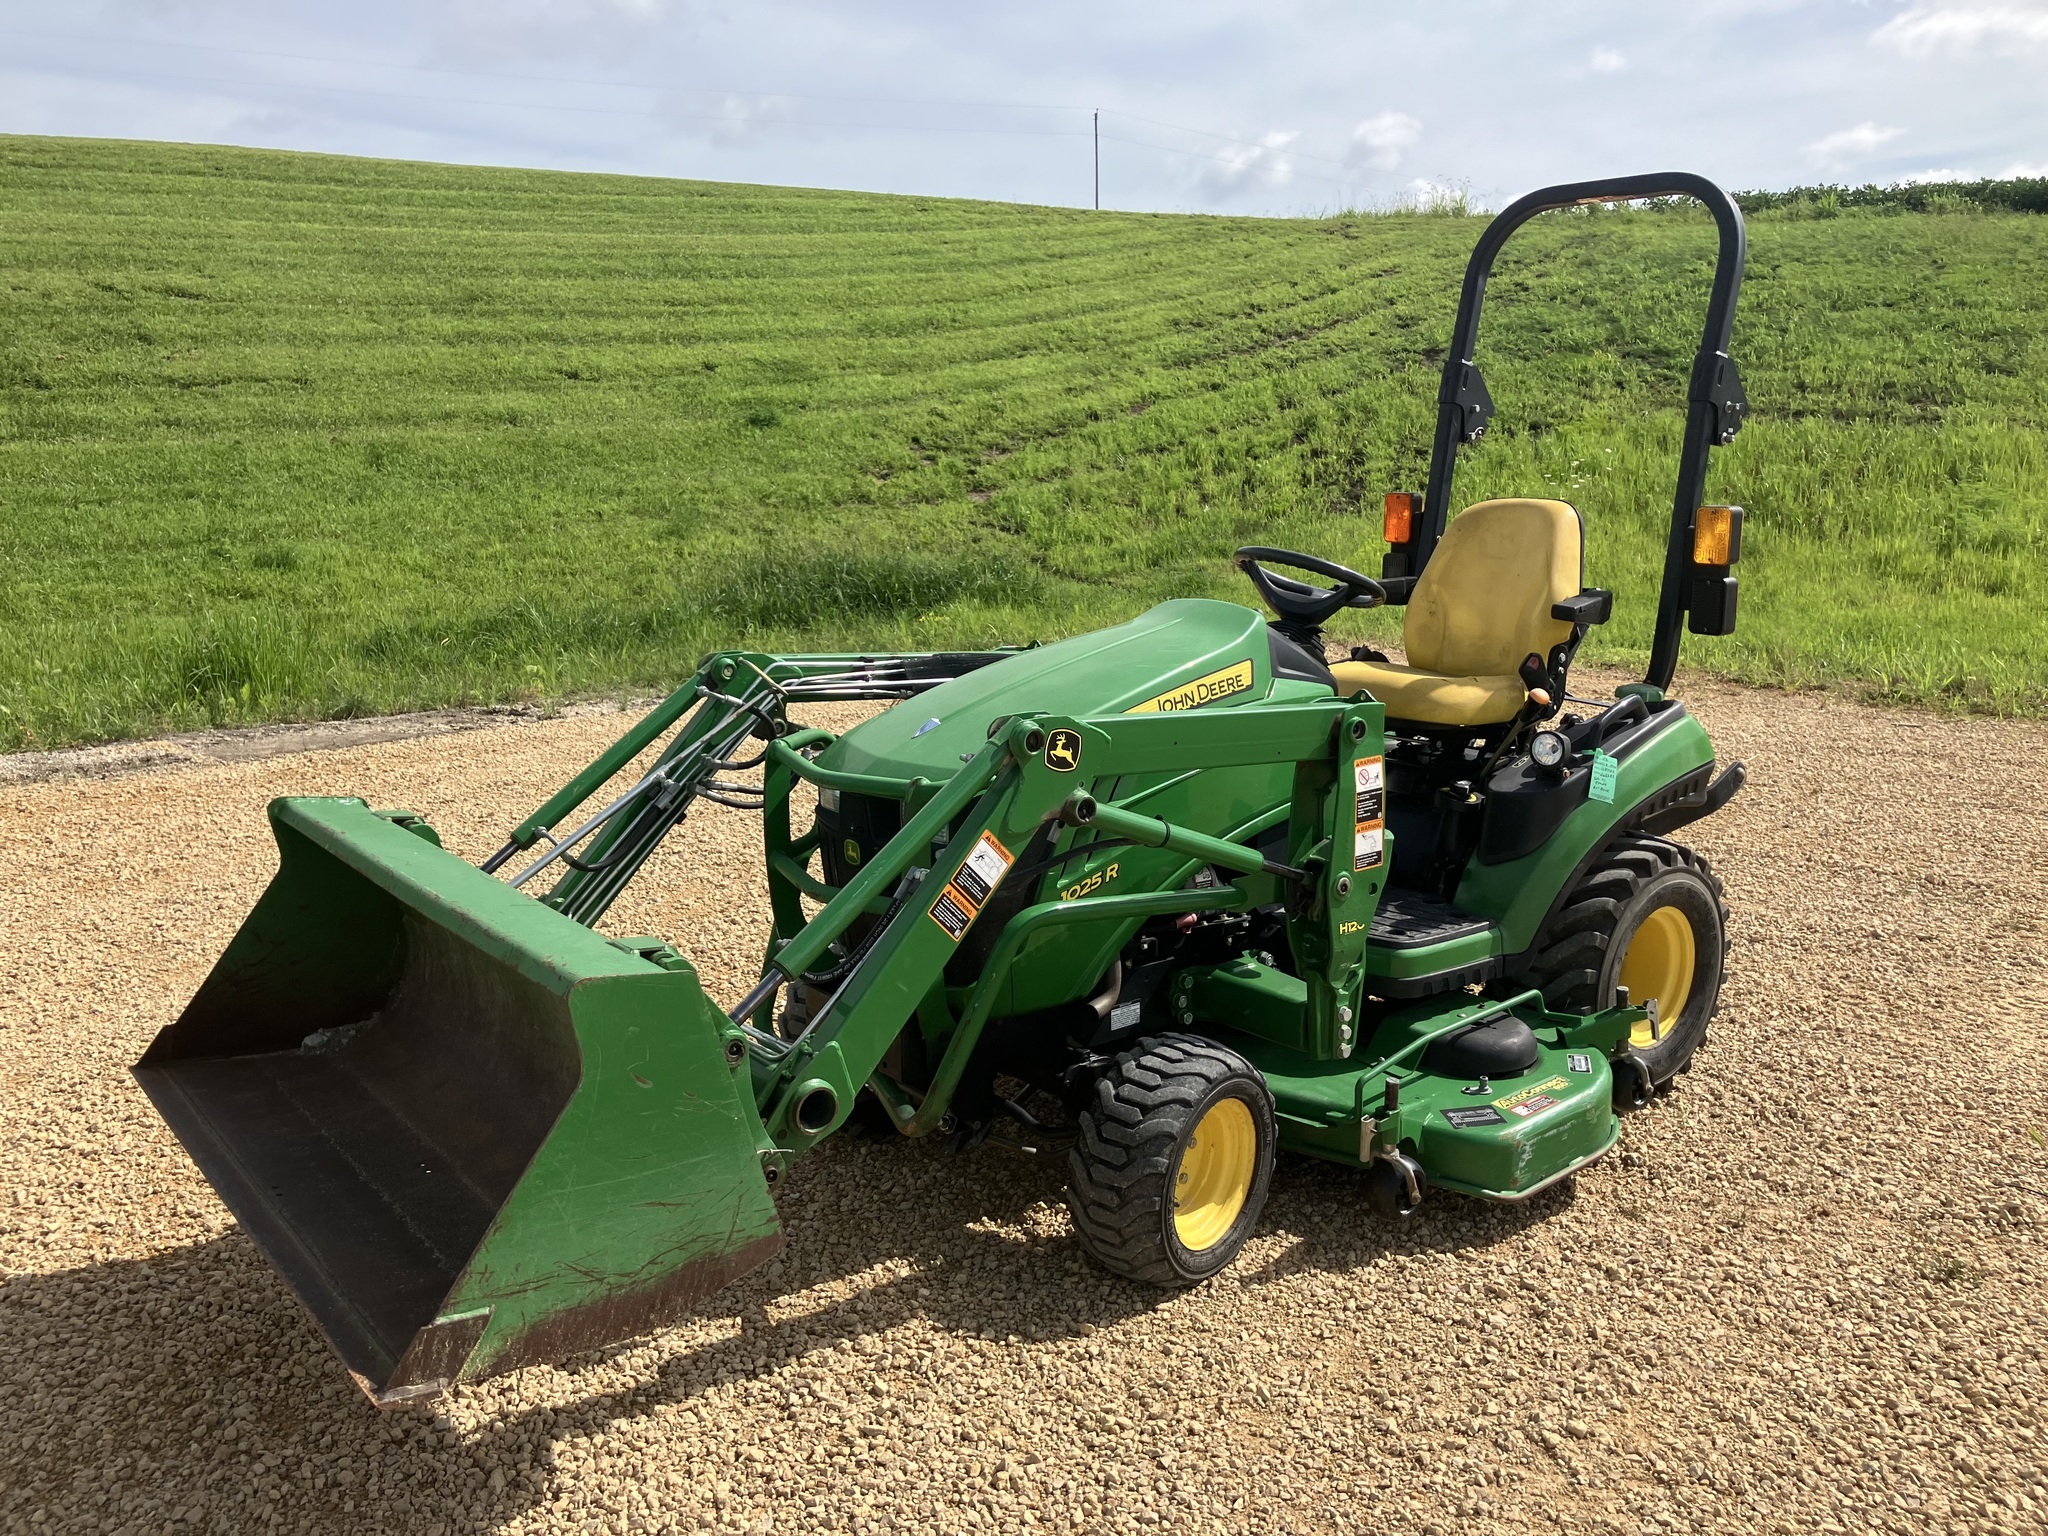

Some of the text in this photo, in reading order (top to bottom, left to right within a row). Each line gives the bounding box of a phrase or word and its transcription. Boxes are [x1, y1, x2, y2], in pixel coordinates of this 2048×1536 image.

[1157, 674, 1244, 712] JOHN DEERE
[1360, 757, 1381, 767] WARNING
[1361, 822, 1382, 832] WARNING
[990, 840, 1010, 862] WARNING
[1061, 863, 1119, 901] 1025 R
[952, 894, 973, 916] WARNING
[1498, 1076, 1566, 1108] AutoConnect
